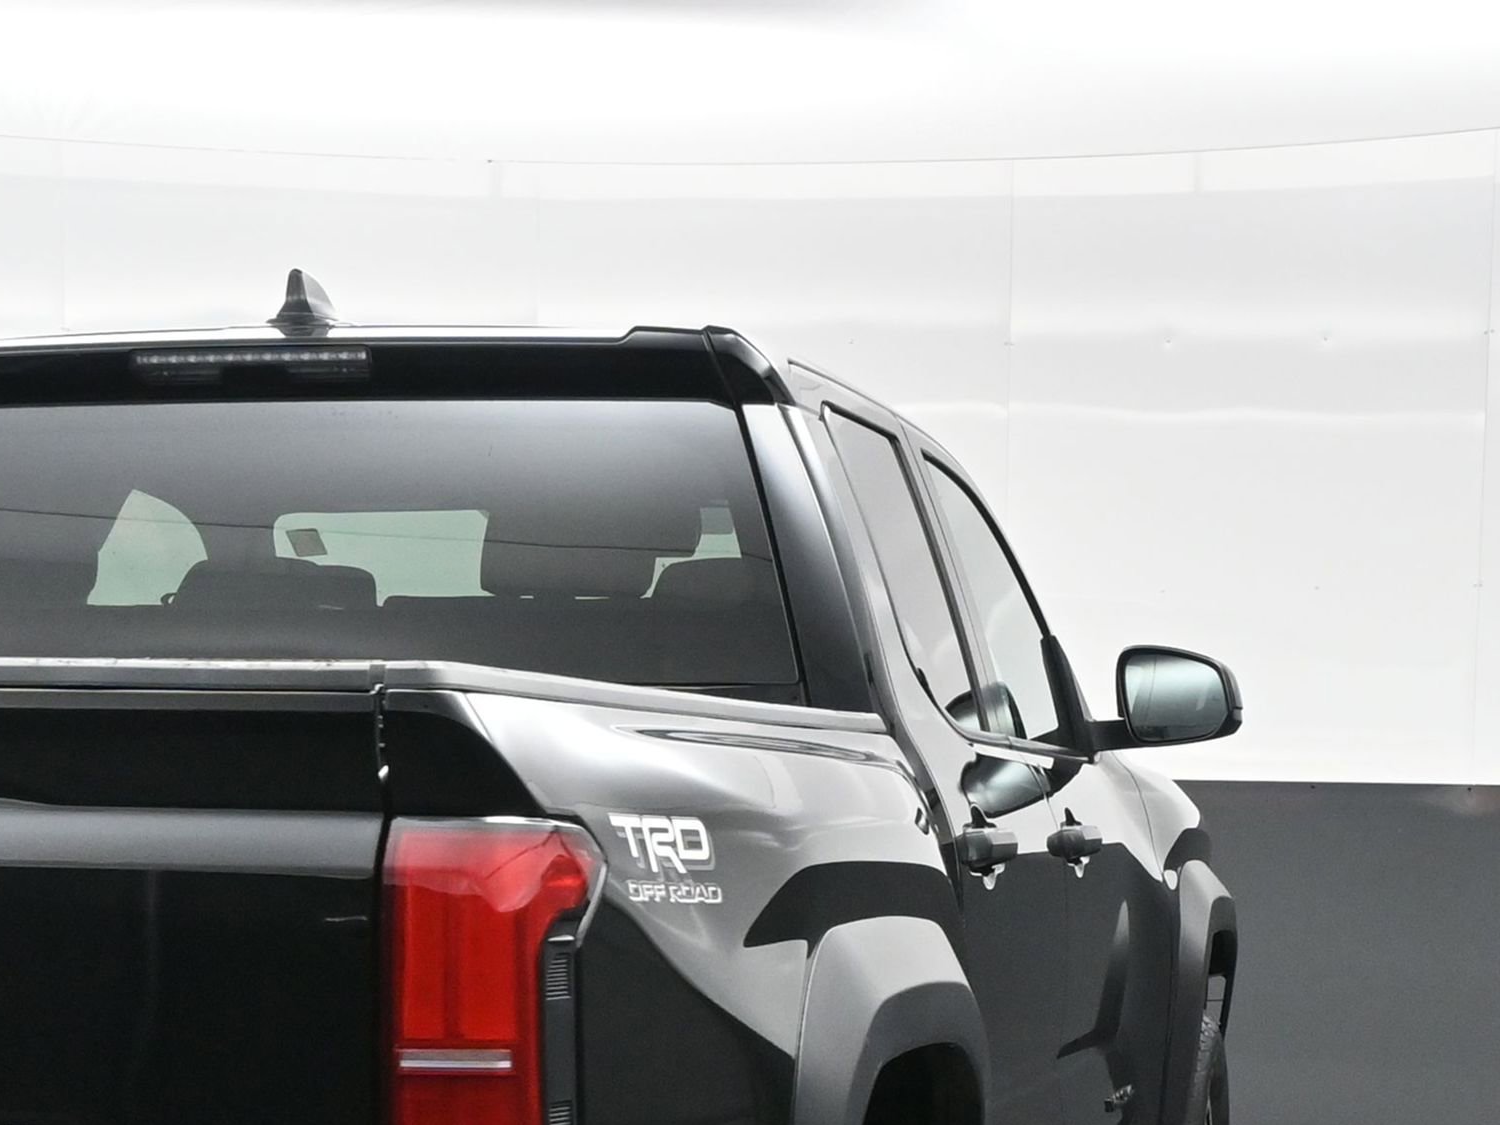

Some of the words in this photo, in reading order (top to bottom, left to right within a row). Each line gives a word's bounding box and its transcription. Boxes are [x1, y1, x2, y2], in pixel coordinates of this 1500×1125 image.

[607, 812, 711, 874] TRD
[627, 881, 666, 903] OFF
[669, 883, 723, 904] ROAD
